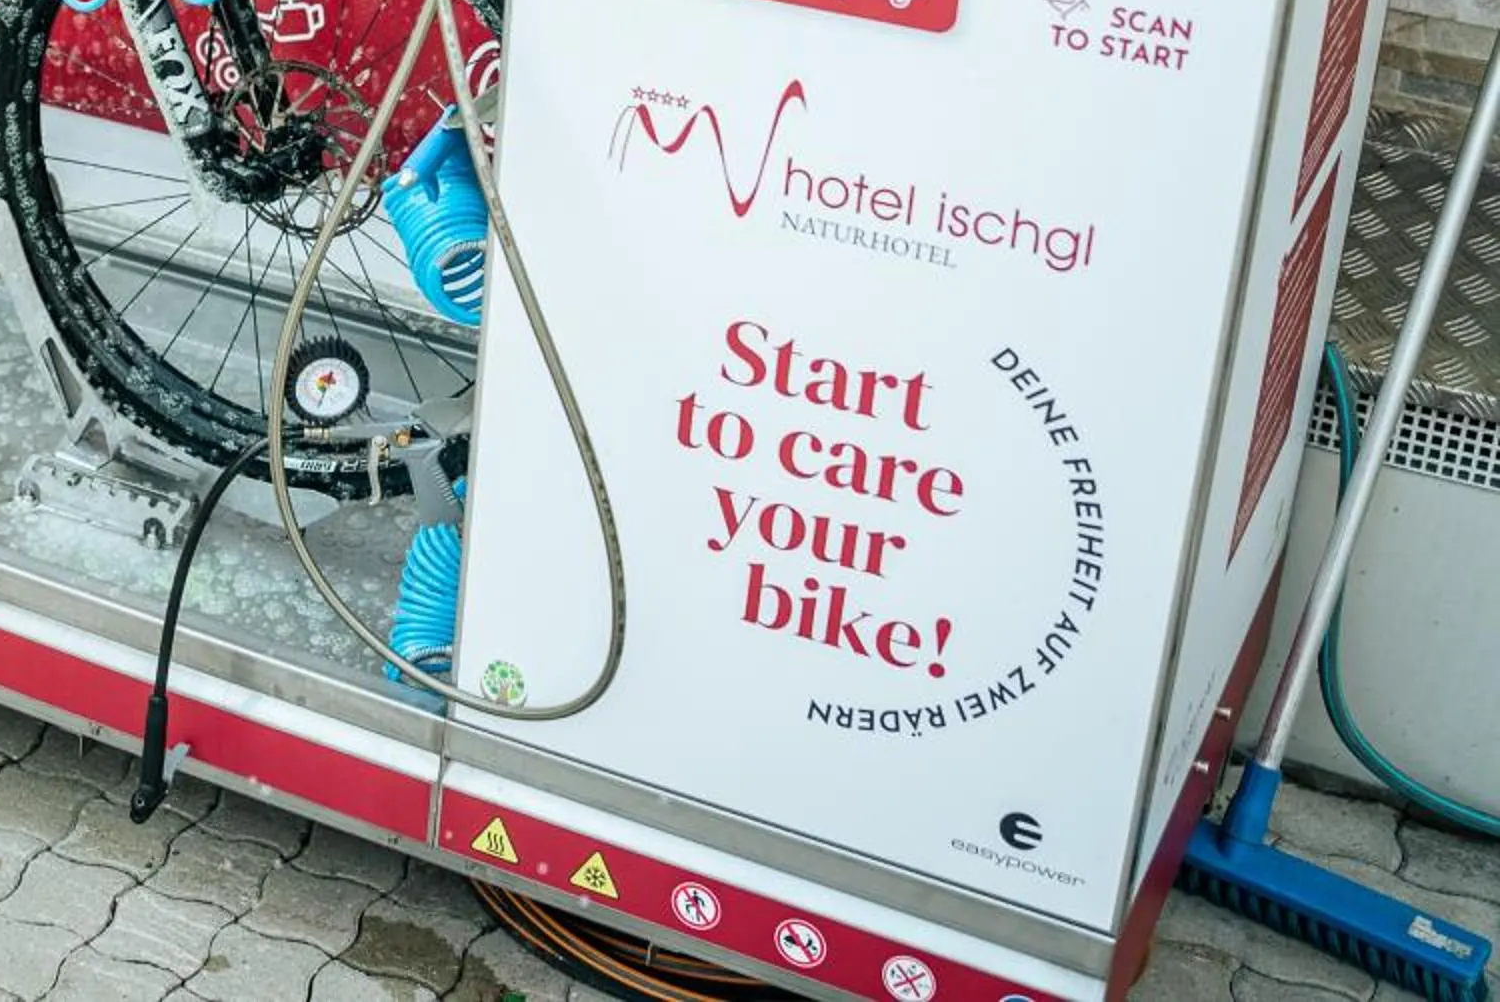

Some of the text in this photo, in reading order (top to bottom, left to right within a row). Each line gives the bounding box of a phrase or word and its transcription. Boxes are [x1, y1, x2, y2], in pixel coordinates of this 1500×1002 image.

[1051, 24, 1190, 71] TO START
[1111, 6, 1193, 40] SCAN
[781, 210, 958, 269] NATURHOTEL
[784, 157, 1095, 272] hotel ischgl
[720, 320, 933, 431] Start
[676, 391, 965, 517] to care
[707, 485, 907, 579] your
[807, 347, 1105, 738] DEINE FREIHEIT AUF ZWEI RÄDERN
[741, 563, 953, 679] bike!
[951, 838, 1086, 887] easypower
